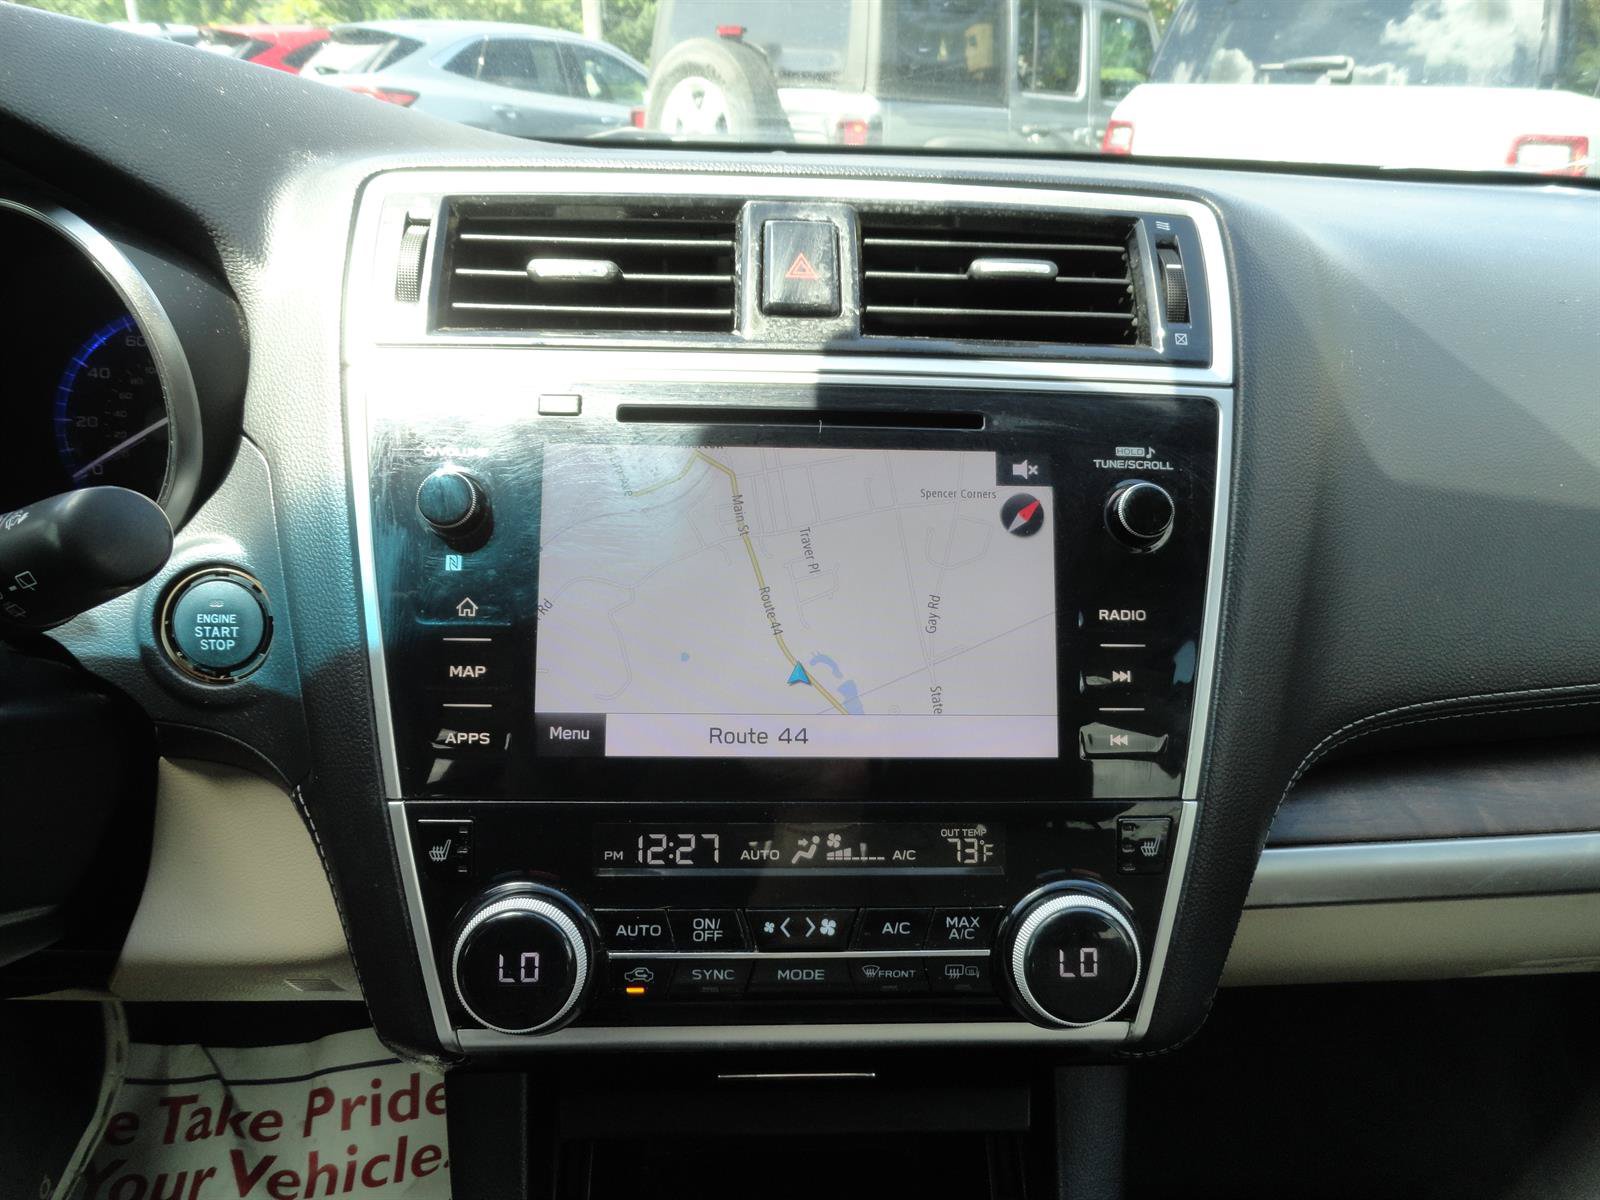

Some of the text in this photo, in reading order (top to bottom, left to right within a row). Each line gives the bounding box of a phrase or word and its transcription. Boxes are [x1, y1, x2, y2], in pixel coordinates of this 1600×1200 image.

[87, 367, 111, 380] 40
[75, 415, 99, 428] 20
[1116, 447, 1144, 456] HOLD
[1093, 459, 1174, 471] TUNE/SCROLL
[920, 488, 997, 500] Spencer Corners
[732, 494, 750, 536] Main St
[800, 527, 821, 574] Traver Pl
[537, 598, 553, 616] Rd
[759, 586, 783, 636] Route 44
[196, 613, 238, 624] ENGINE
[925, 595, 941, 634] Gay Rd
[1099, 609, 1147, 621] RADIO
[194, 626, 240, 637] START
[200, 639, 236, 651] STOP
[449, 665, 487, 678] MAP
[930, 685, 943, 714] State
[445, 732, 490, 745] APPS
[549, 726, 590, 740] Menu
[709, 727, 809, 745] Route 44
[940, 828, 987, 837] OUT TEMP
[604, 834, 720, 865] PM 12:27
[740, 850, 780, 860] AUTO
[892, 850, 917, 860] A/C
[692, 918, 721, 930] ON/
[881, 922, 911, 935] A/C
[946, 916, 980, 928] MAX
[615, 924, 662, 937] AUTO
[692, 930, 723, 943] OFF
[948, 928, 976, 940] A/C
[691, 969, 736, 981] SYNC
[777, 969, 825, 981] MODE
[878, 969, 916, 979] FRONT
[105, 1072, 446, 1146] e Take Pride
[229, 1135, 449, 1200] Vehicle
